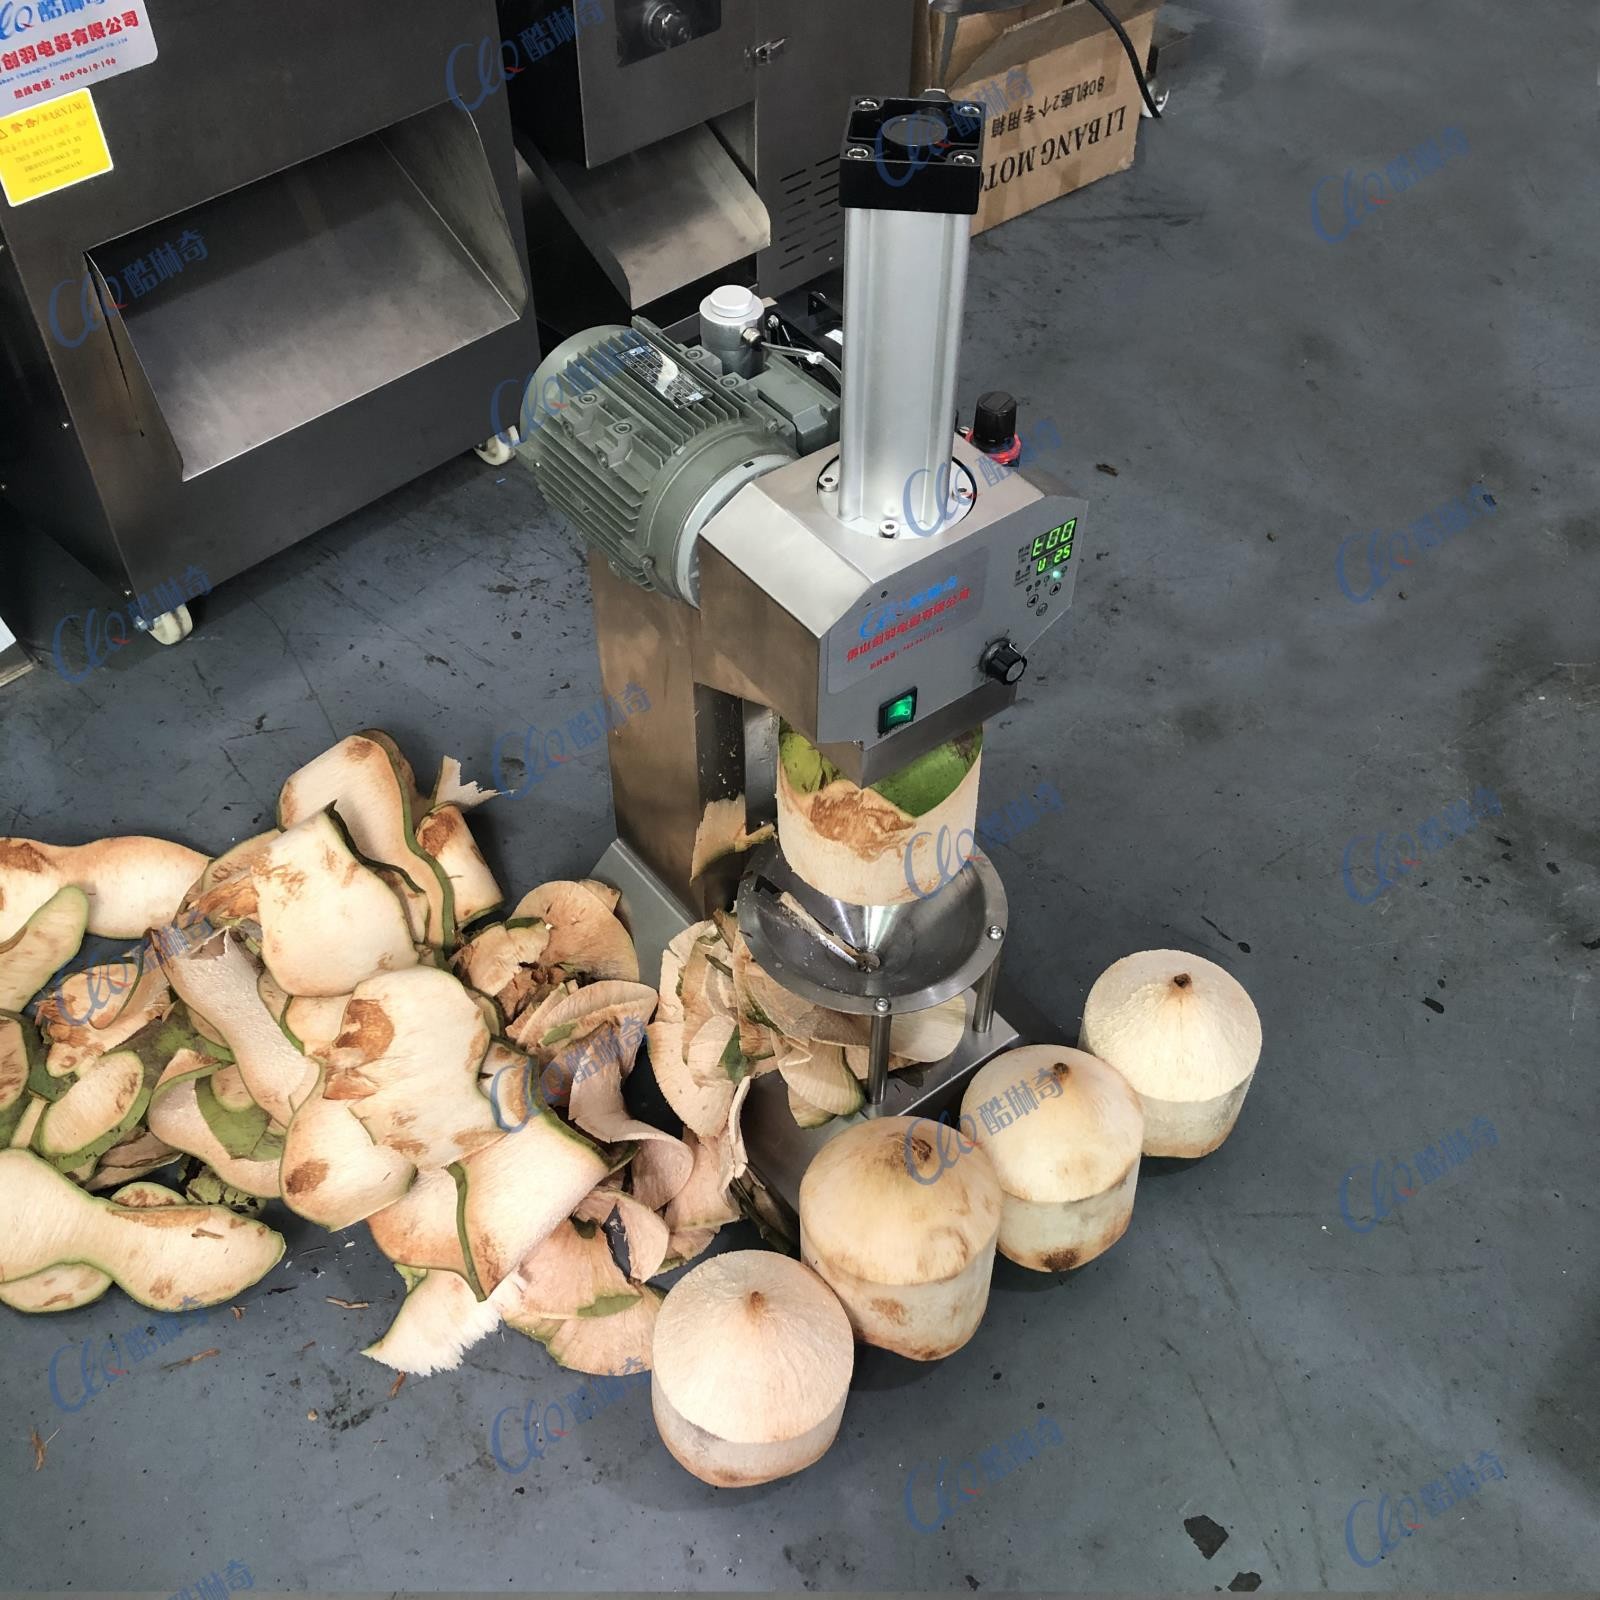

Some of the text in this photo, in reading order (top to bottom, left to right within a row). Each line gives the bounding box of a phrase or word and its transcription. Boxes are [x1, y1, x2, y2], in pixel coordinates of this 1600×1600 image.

[0, 10, 139, 73] 创羽电器有限公司
